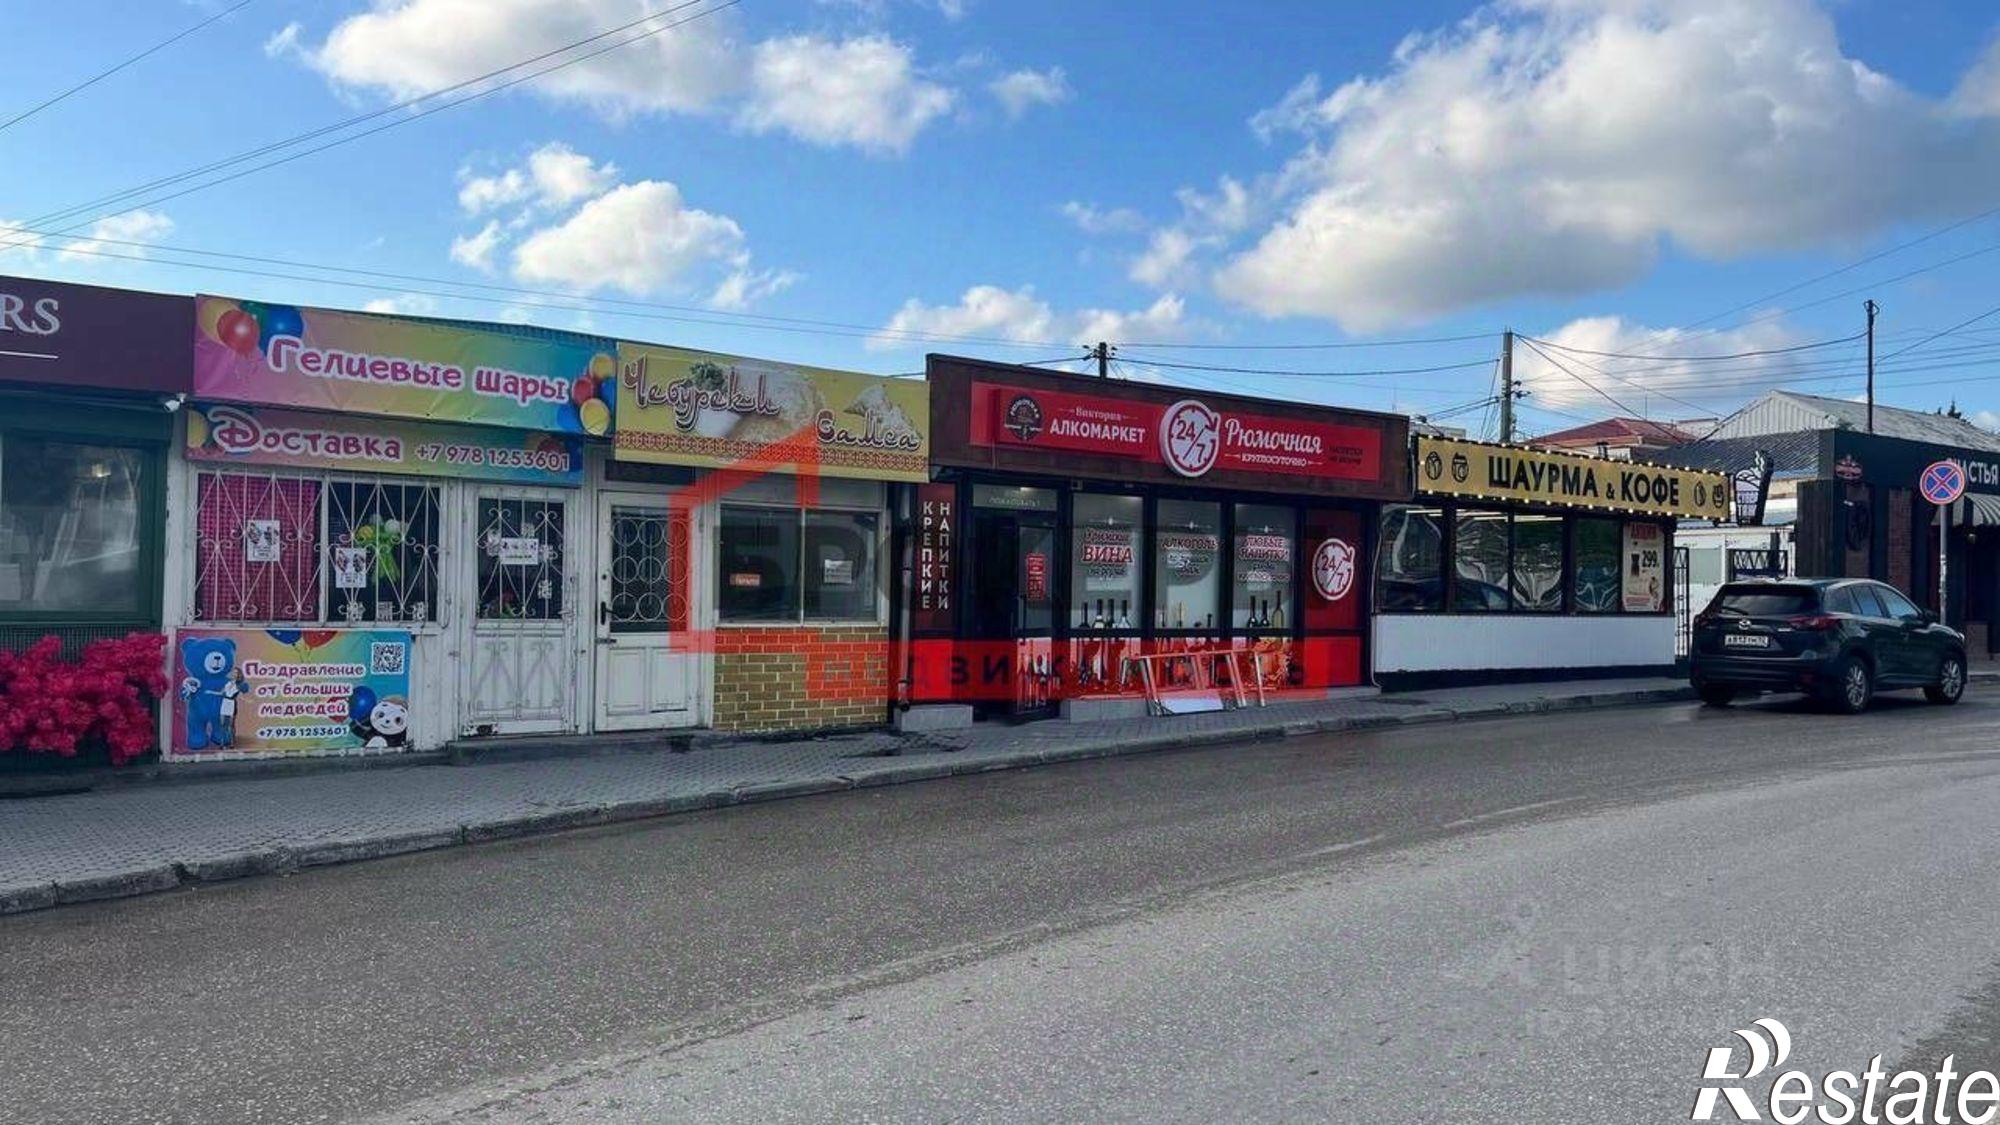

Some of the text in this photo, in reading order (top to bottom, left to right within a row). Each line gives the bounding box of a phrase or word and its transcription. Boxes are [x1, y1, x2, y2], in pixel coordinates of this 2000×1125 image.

[271, 338, 569, 403] Гелиевые шары
[624, 353, 781, 432] Чебуреки
[208, 408, 570, 471] Доставка +7 978 1253601
[1050, 418, 1145, 443] АЛКОМАРКЕТ
[1225, 418, 1323, 455] Рюмочная
[1488, 455, 1680, 507] ШАУРМА & КОФЕ
[1946, 458, 1998, 485] СТЬЯ
[921, 501, 933, 609] КРЕПКИЕ
[938, 502, 950, 610] НАПИТКИ
[1082, 545, 1134, 563] ВИНА
[245, 660, 365, 678] Поздравление
[257, 682, 352, 696] от больших
[260, 700, 347, 716] медведей
[258, 726, 348, 738] +7 978 1253601
